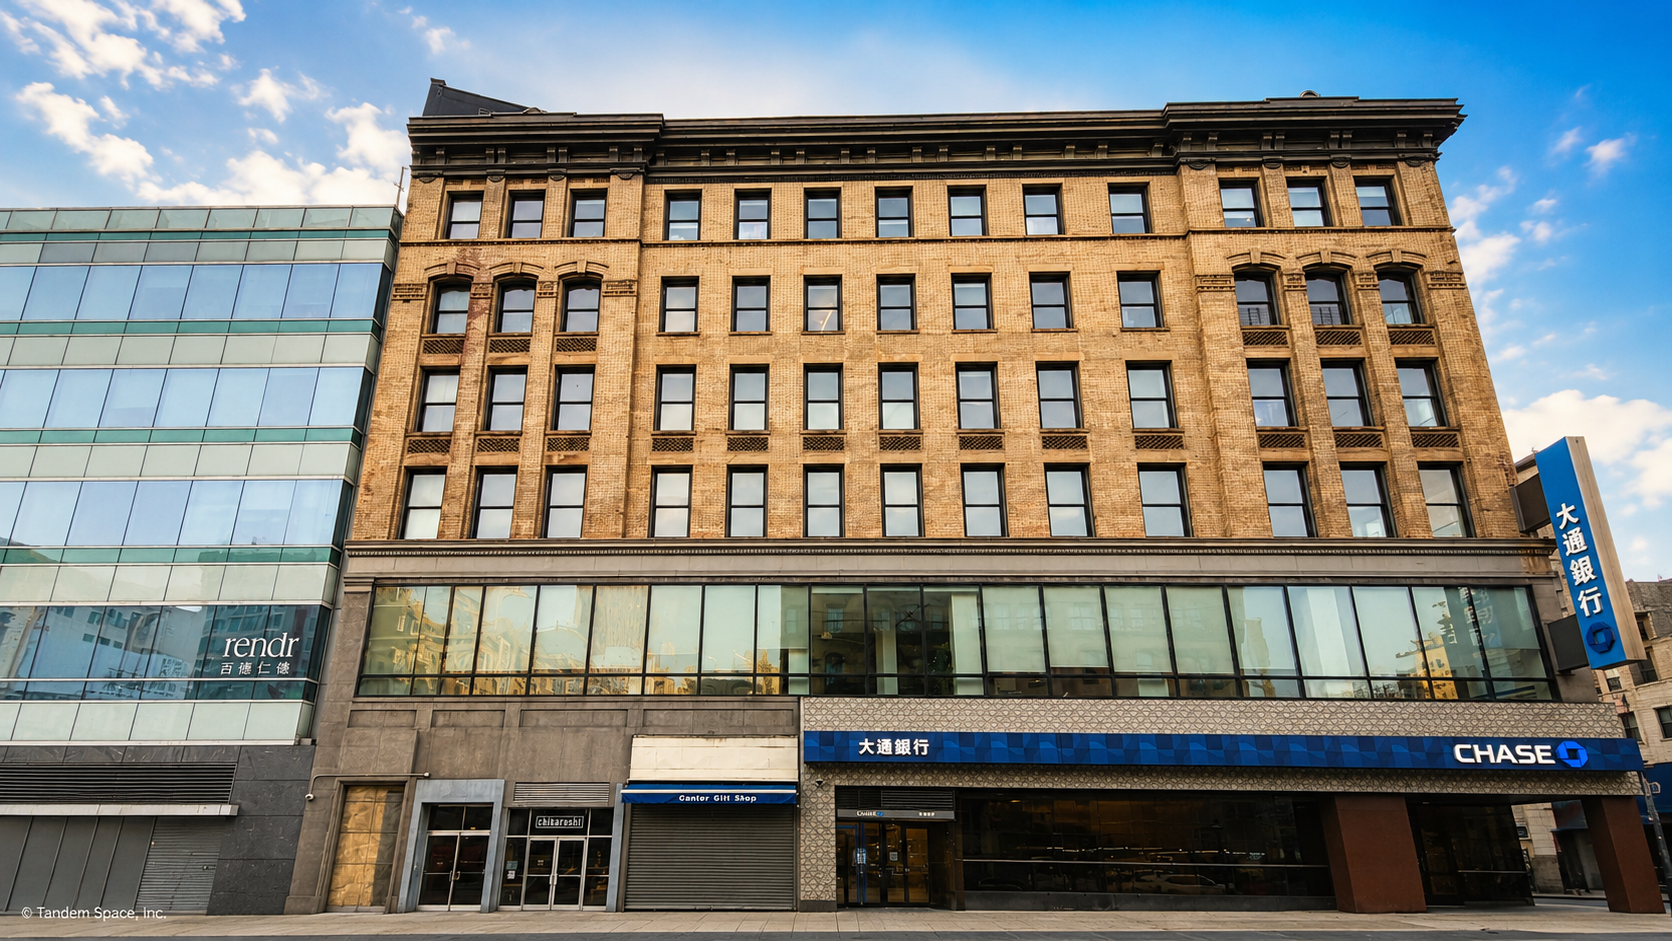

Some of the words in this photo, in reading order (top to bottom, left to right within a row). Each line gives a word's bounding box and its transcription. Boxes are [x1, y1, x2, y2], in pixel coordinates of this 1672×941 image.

[1556, 503, 1603, 617] 大通銀行
[222, 632, 300, 658] rendr
[858, 738, 930, 756] 大通銀行
[1453, 744, 1556, 765] CHASE
[734, 794, 757, 804] Shop
